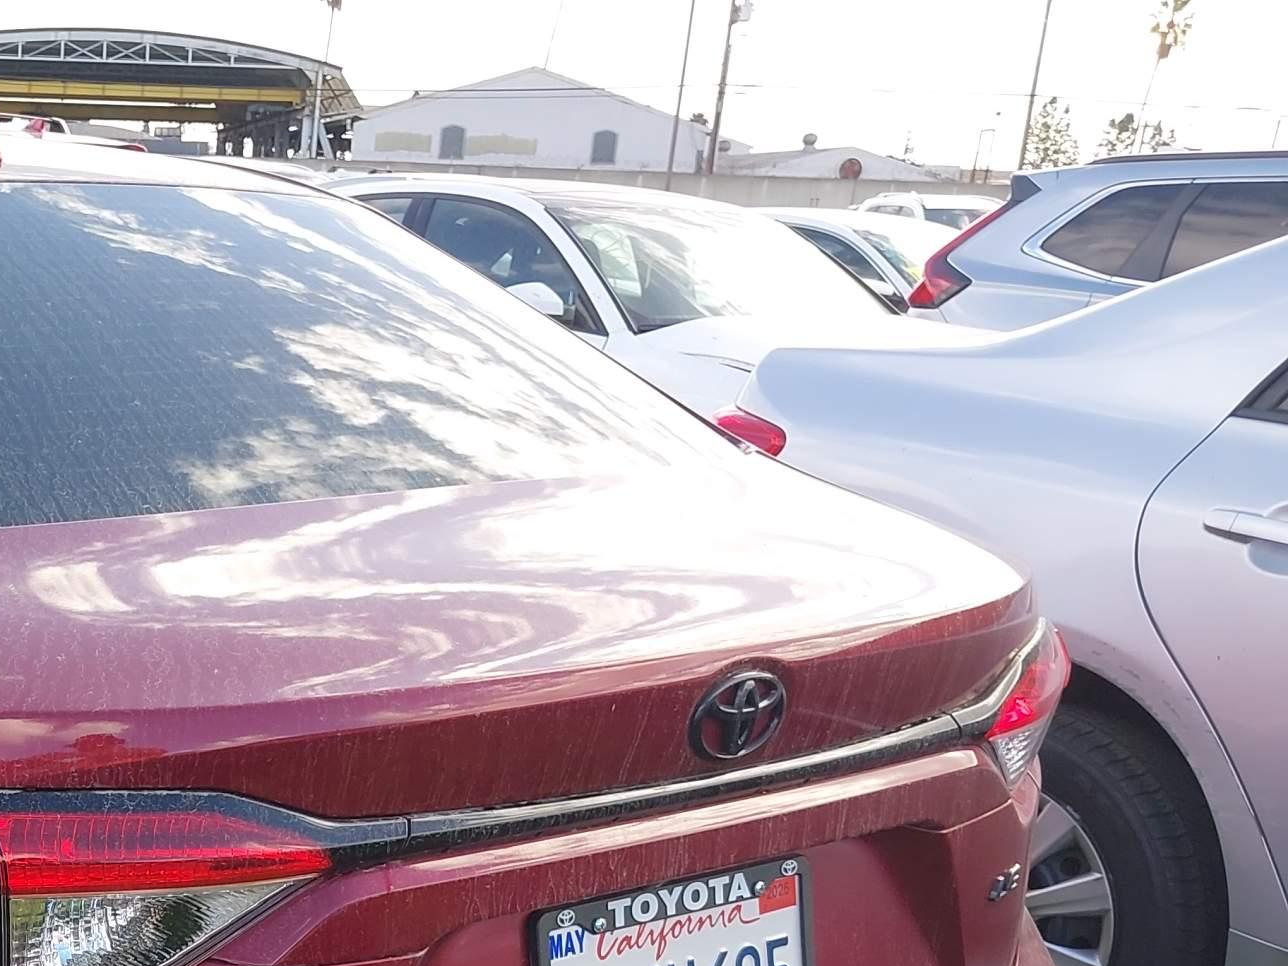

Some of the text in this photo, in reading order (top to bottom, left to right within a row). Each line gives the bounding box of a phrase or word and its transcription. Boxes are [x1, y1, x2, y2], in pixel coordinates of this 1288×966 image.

[609, 873, 751, 927] TOYOTA
[549, 931, 586, 960] MAY
[596, 904, 760, 960] California
